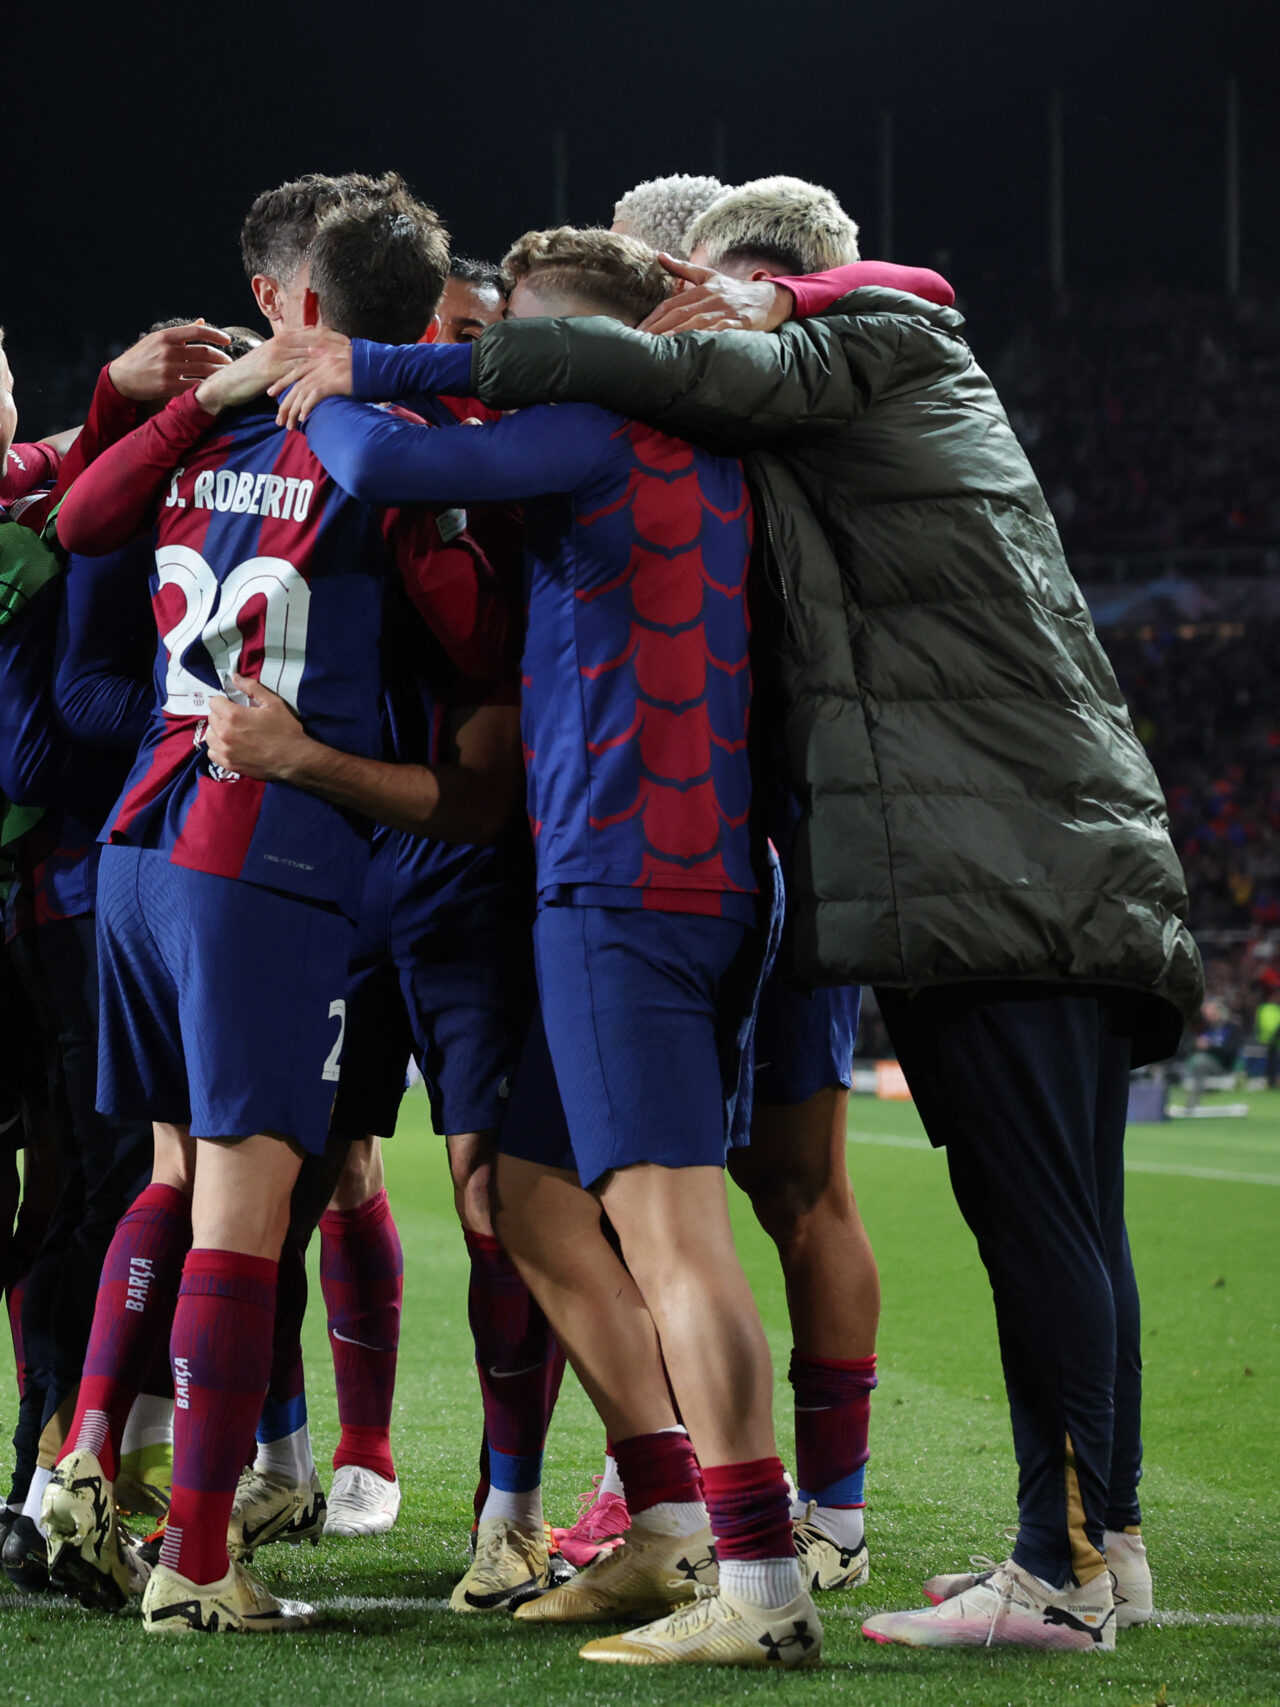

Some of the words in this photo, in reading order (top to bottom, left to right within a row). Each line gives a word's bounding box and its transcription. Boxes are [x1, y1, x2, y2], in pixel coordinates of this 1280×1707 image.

[165, 467, 186, 508] S.
[194, 469, 315, 523] ROBERTO
[154, 544, 312, 716] 20
[124, 1257, 156, 1313] BARÇA
[174, 1357, 193, 1410] BARÇA
